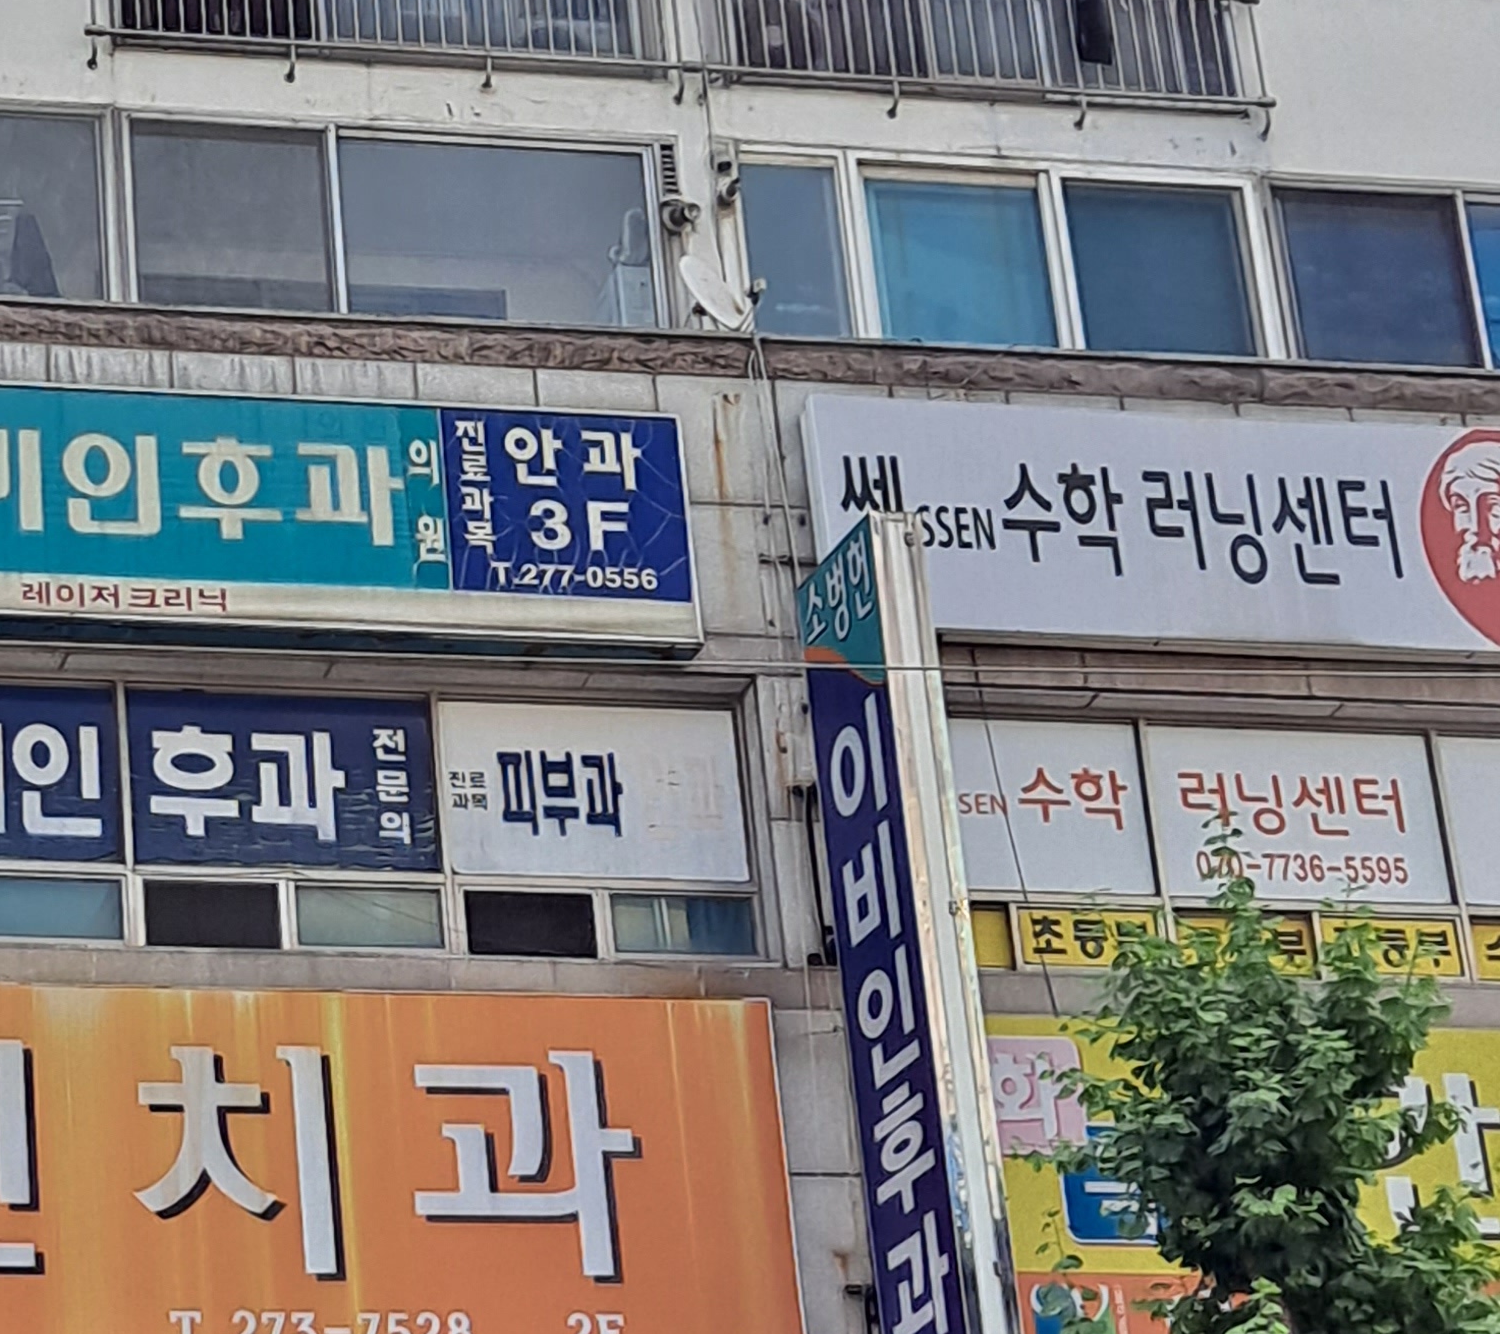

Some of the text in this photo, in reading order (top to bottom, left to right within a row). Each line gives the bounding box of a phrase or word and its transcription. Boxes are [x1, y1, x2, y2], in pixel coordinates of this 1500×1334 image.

[454, 420, 497, 556] 진료과목
[504, 426, 642, 491] 안과
[529, 499, 630, 551] 3F
[1002, 462, 1124, 577] 수학
[1141, 470, 1404, 586] 러닝센터
[806, 530, 874, 645] 소병헌
[496, 750, 623, 837] 피부과
[1018, 767, 1128, 830] 수학
[1177, 772, 1406, 836] 러닝센터
